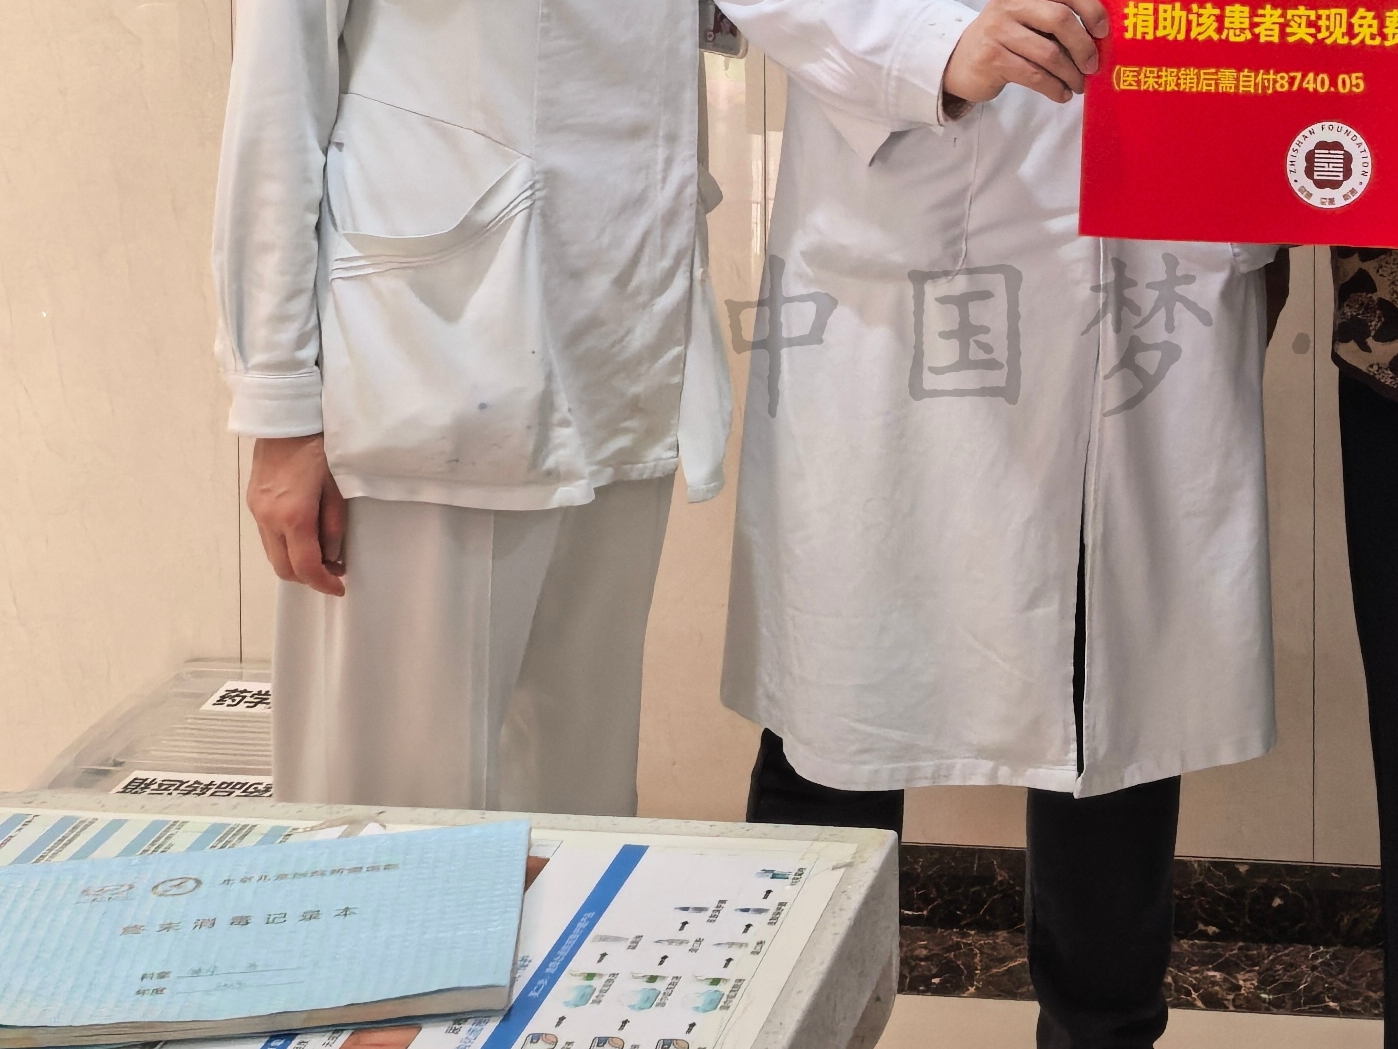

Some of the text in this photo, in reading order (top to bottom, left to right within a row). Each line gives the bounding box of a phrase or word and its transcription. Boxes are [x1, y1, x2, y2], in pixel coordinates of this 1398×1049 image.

[1288, 124, 1370, 177] ZHISHAN FOUNDATION
[211, 687, 272, 710] 药学
